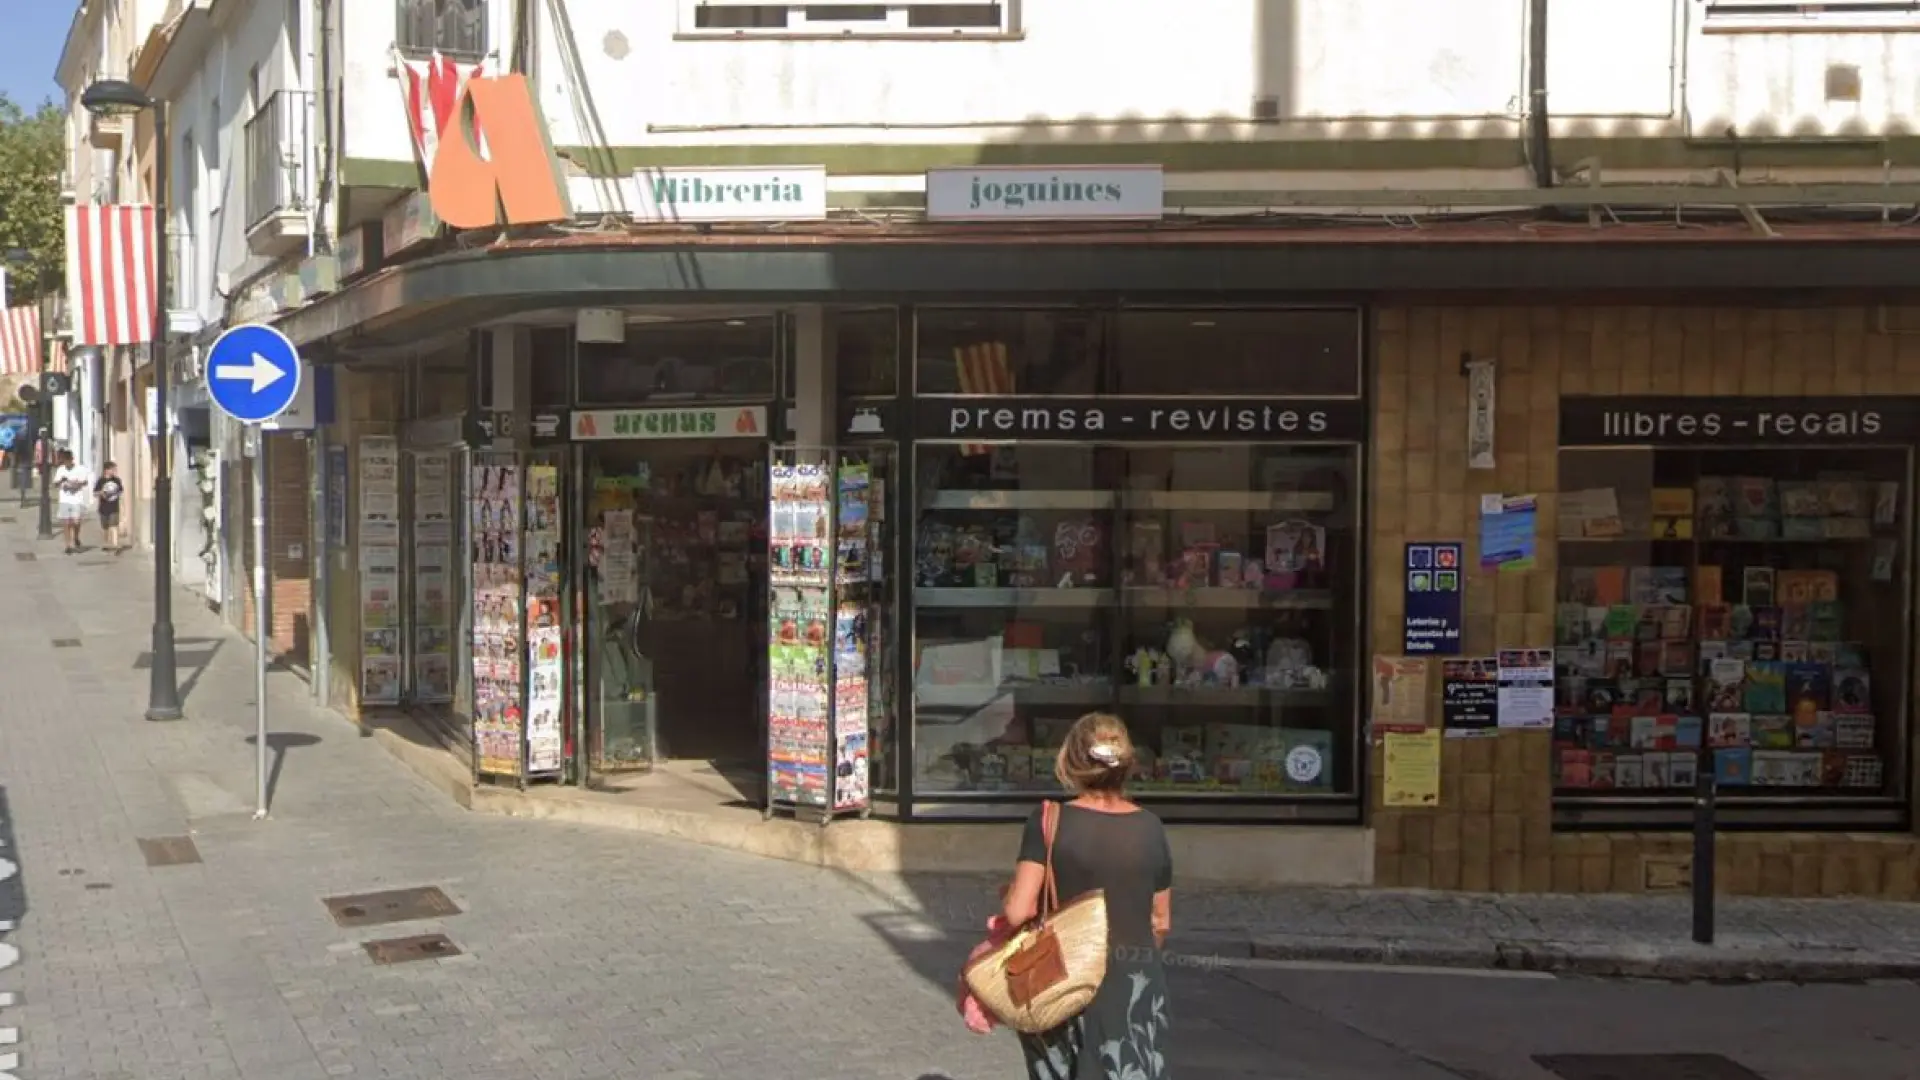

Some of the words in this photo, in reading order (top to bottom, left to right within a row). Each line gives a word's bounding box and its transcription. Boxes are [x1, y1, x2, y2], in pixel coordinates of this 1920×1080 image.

[653, 177, 803, 203] llibreria
[969, 176, 1122, 209] joguines
[949, 405, 1105, 433] premsa
[1150, 405, 1328, 432] revistes
[1603, 411, 1722, 437] llibres
